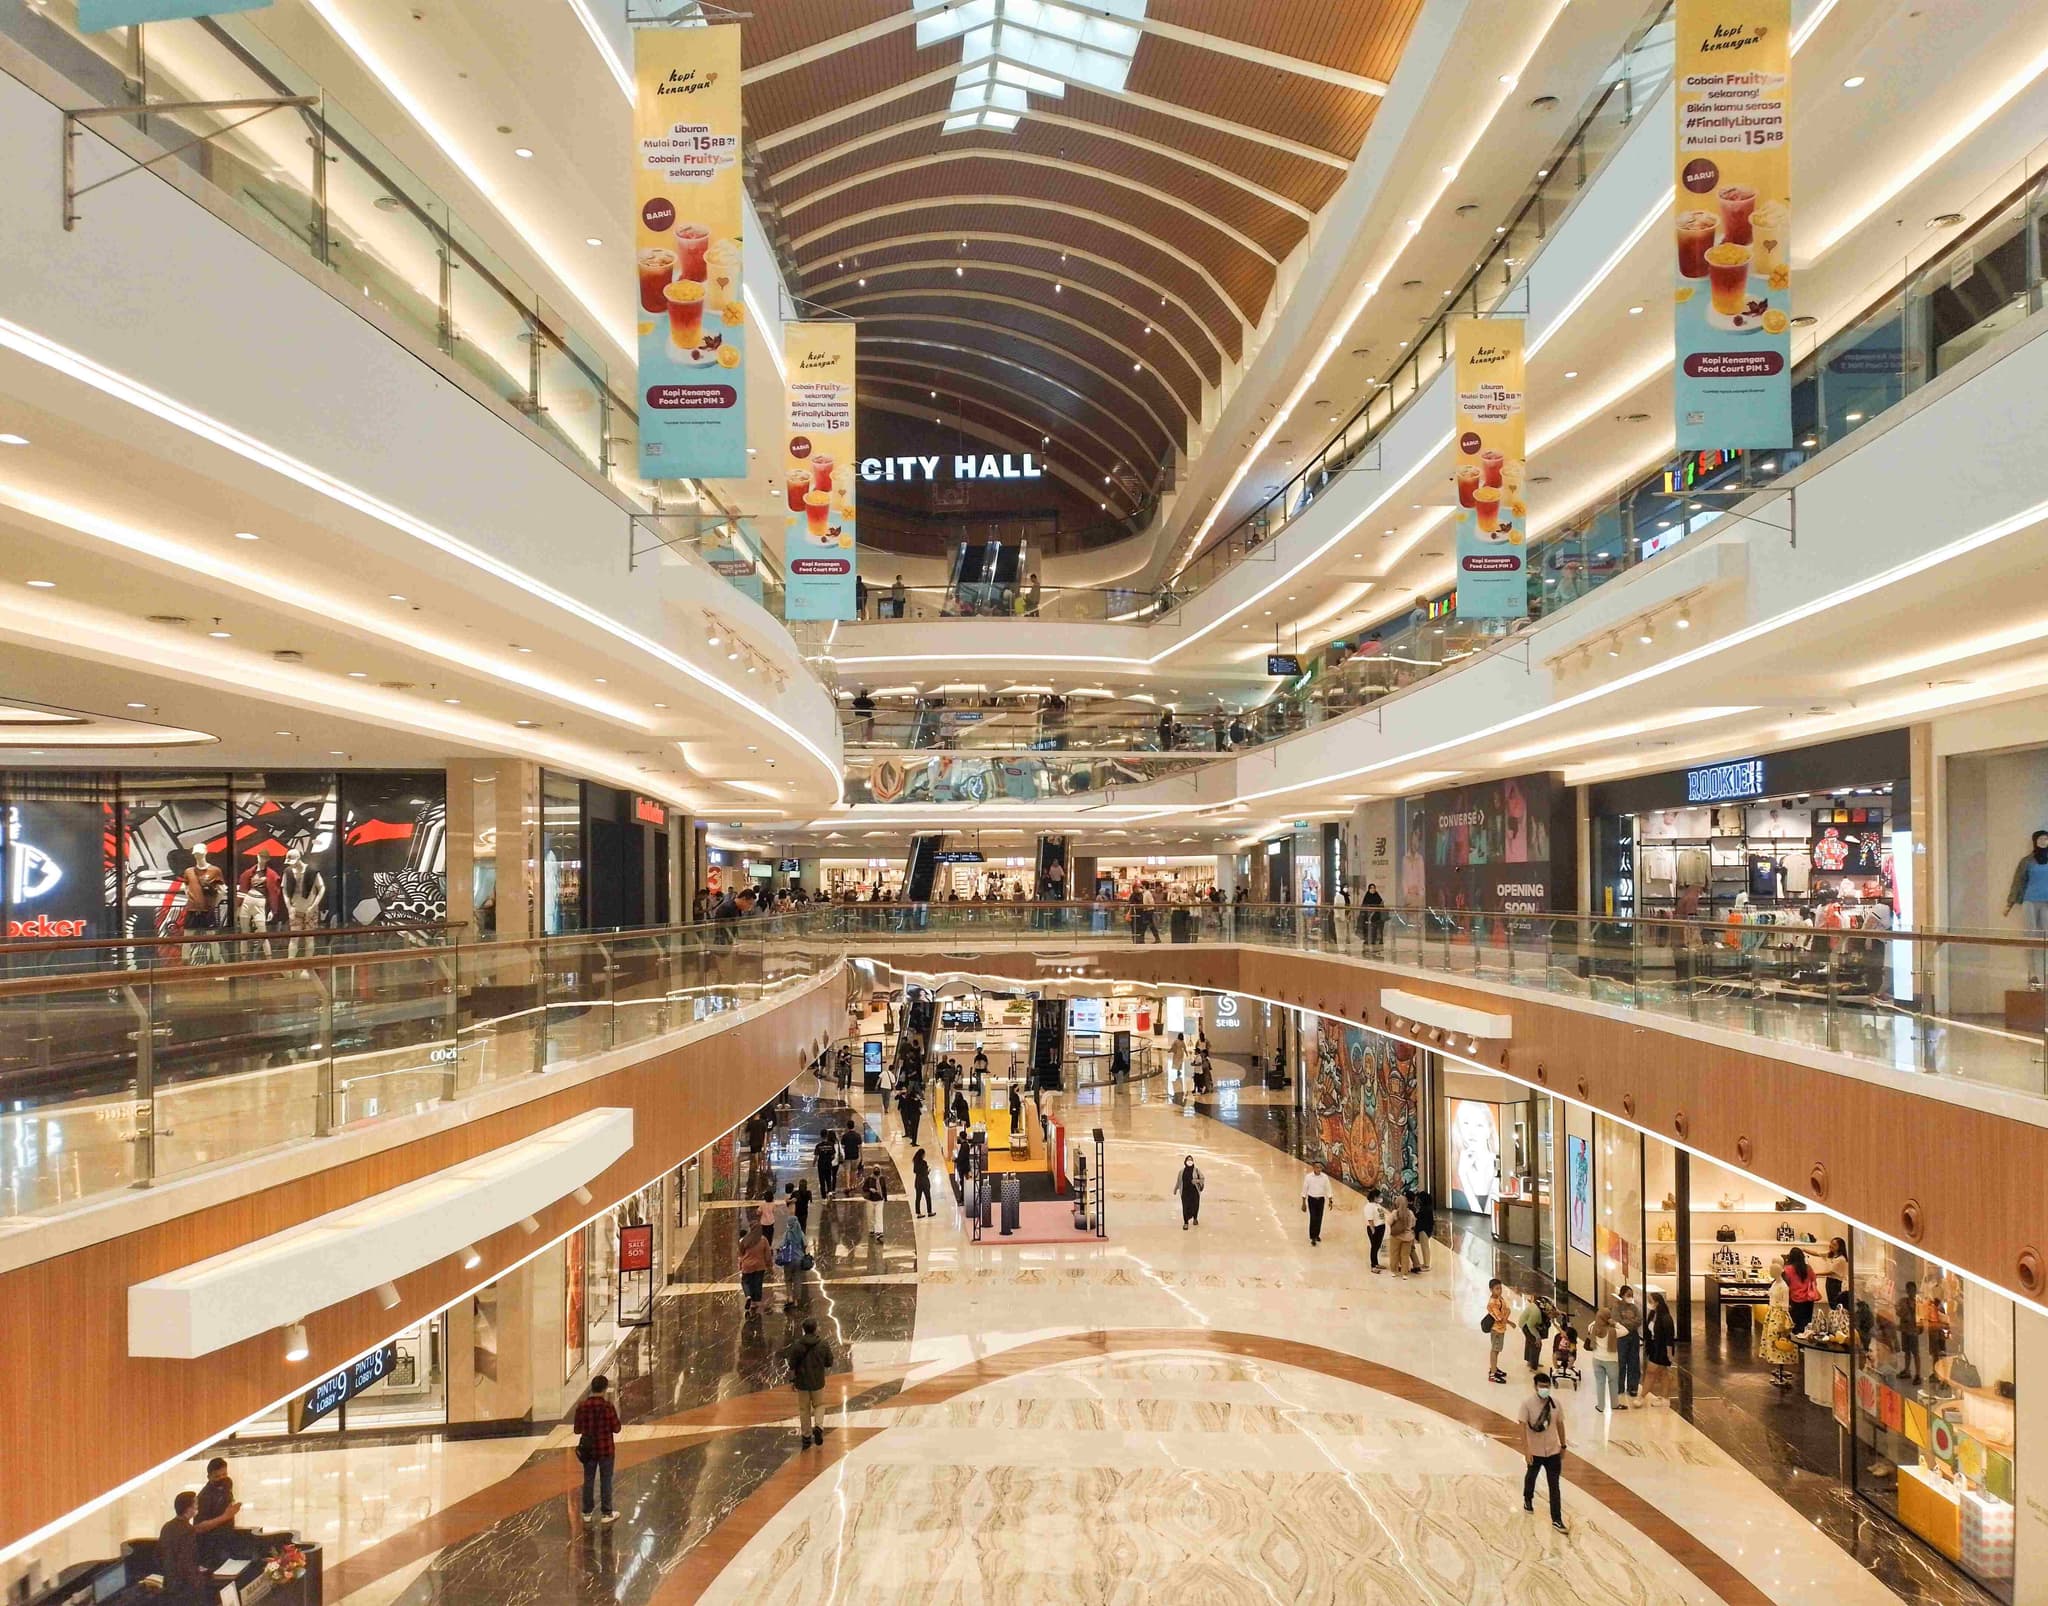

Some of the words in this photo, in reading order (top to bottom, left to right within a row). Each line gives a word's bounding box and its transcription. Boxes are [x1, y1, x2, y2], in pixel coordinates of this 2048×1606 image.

[1714, 24, 1743, 38] kopi
[1700, 37, 1760, 52] kenangan
[669, 69, 696, 82] kopi
[1687, 75, 1724, 86] Cobain
[1726, 72, 1768, 86] Fruity
[657, 81, 710, 95] kenangan
[1708, 88, 1760, 99] sekarang!
[1687, 103, 1712, 113] Bikin
[1713, 102, 1743, 112] kamu
[1745, 102, 1781, 111] serasa
[1686, 115, 1782, 129] #FinallyLiburan
[675, 125, 708, 133] Liburan
[644, 140, 670, 148] Mulai
[672, 139, 691, 147] Dari
[1687, 135, 1717, 144] Mulai
[1719, 133, 1741, 144] Dari
[648, 154, 680, 163] Cobain
[683, 153, 719, 165] Fruity
[669, 168, 714, 178] sekarang!
[1686, 171, 1715, 182] BARU!
[646, 209, 672, 220] BARU!
[1702, 356, 1721, 364] Kopi
[1722, 356, 1766, 364] Kenangan
[1746, 364, 1762, 372] PIM
[663, 389, 680, 397] Kopi
[681, 389, 721, 397] Kenangan
[815, 383, 840, 391] Fruity
[860, 456, 940, 481] CITY
[954, 453, 1041, 479] HALL
[1688, 762, 1749, 800] ROOKIE
[1439, 811, 1477, 828] CONVERSE
[1496, 884, 1544, 897] OPENING
[1504, 902, 1536, 914] SOON
[1216, 1019, 1240, 1027] SEIBU
[355, 1354, 375, 1375] PINTU
[374, 1348, 383, 1375] 8
[355, 1369, 373, 1388] LOBBY
[316, 1376, 338, 1400] PINTU
[337, 1371, 347, 1400] 9
[316, 1391, 337, 1413] LOBBY
